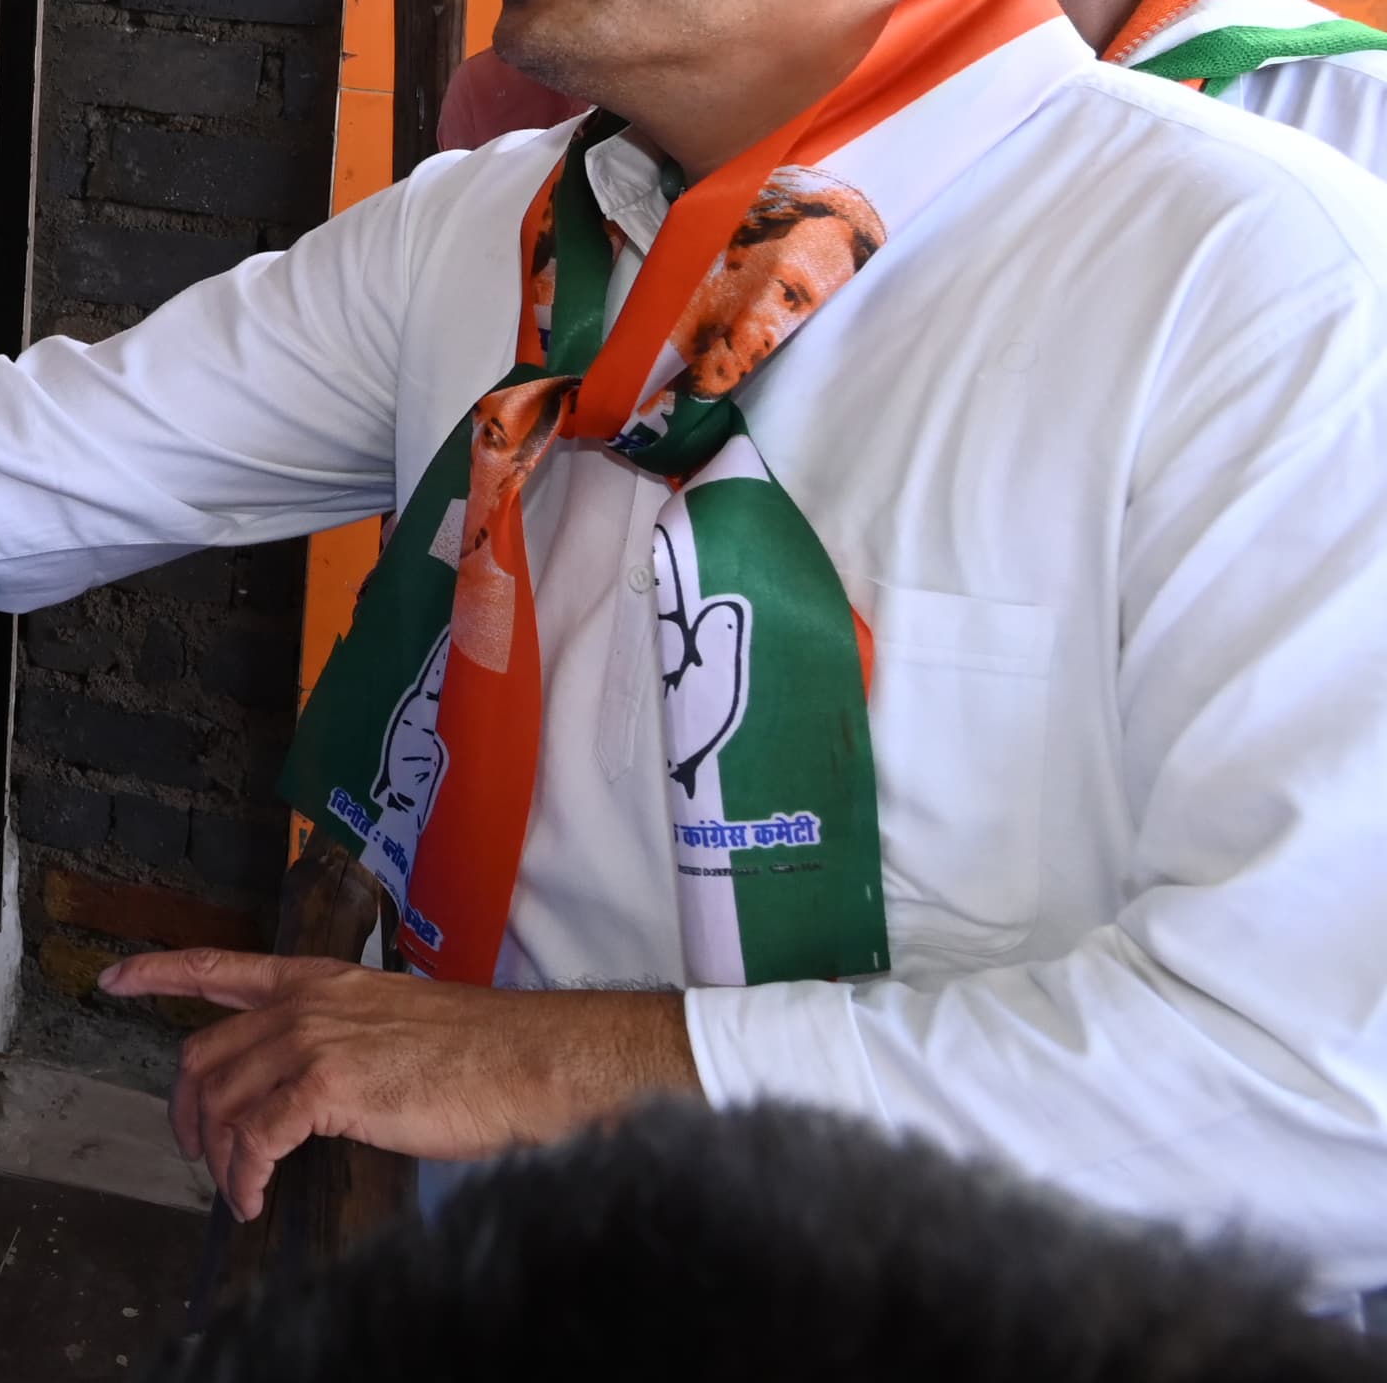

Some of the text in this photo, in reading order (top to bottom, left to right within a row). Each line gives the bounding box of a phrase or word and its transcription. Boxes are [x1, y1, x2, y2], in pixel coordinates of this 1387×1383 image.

[329, 787, 373, 839] विनीत
[680, 814, 815, 849] कांग्रेस कमेटी
